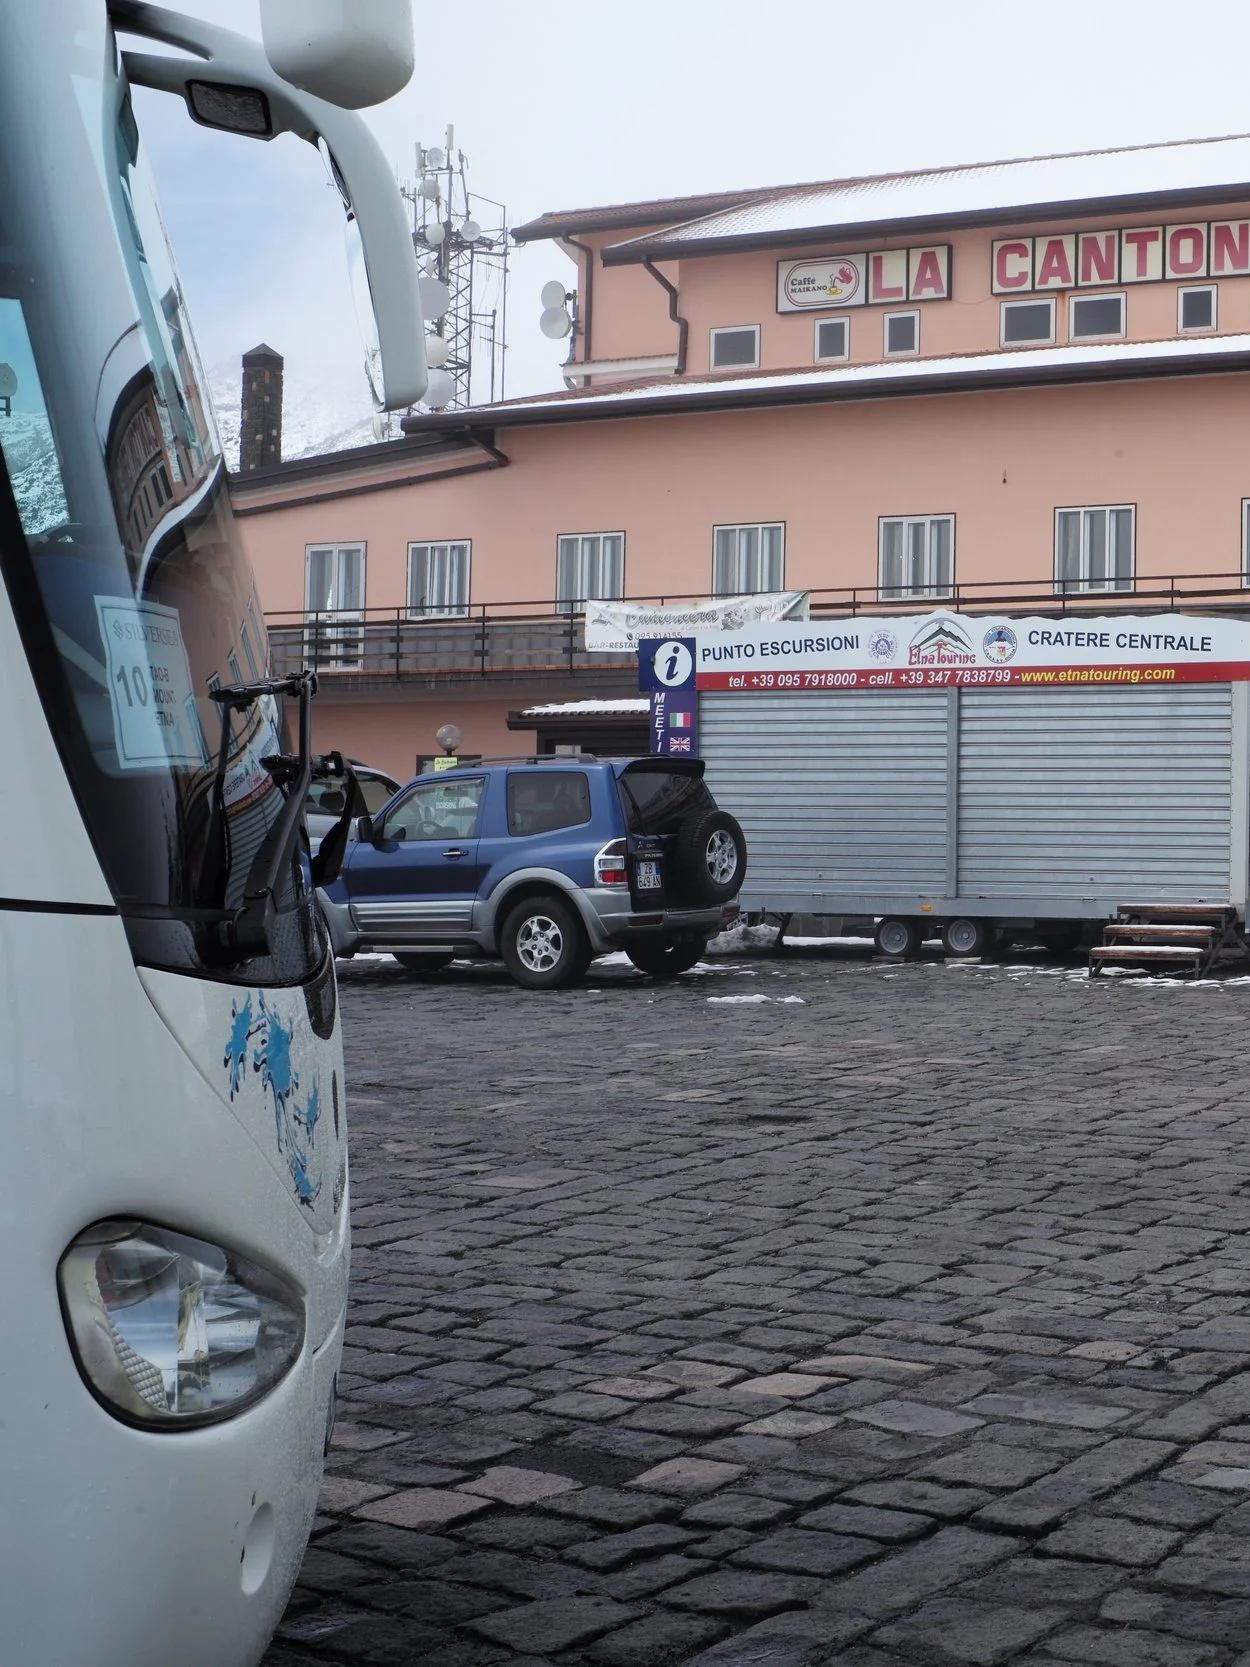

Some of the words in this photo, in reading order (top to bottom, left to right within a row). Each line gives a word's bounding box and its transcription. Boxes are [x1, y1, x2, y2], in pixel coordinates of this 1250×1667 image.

[872, 250, 946, 300] LA
[790, 285, 828, 294] MAIKANO
[702, 643, 756, 662] PUNTO
[759, 634, 860, 657] ESCURSIONI
[1028, 630, 1110, 648] CRATERE
[1116, 633, 1213, 652] CENTRALE
[116, 665, 148, 708] 10
[728, 674, 748, 688] tel.
[751, 674, 775, 687] +39
[777, 673, 801, 687] 095
[804, 672, 857, 686] 7918000
[869, 671, 895, 685] cell.
[900, 671, 924, 684] +39
[927, 671, 952, 684] 347
[955, 669, 1011, 683] 7838799
[1021, 667, 1176, 683] www.etnatouring.com
[153, 688, 176, 704] MOUNT
